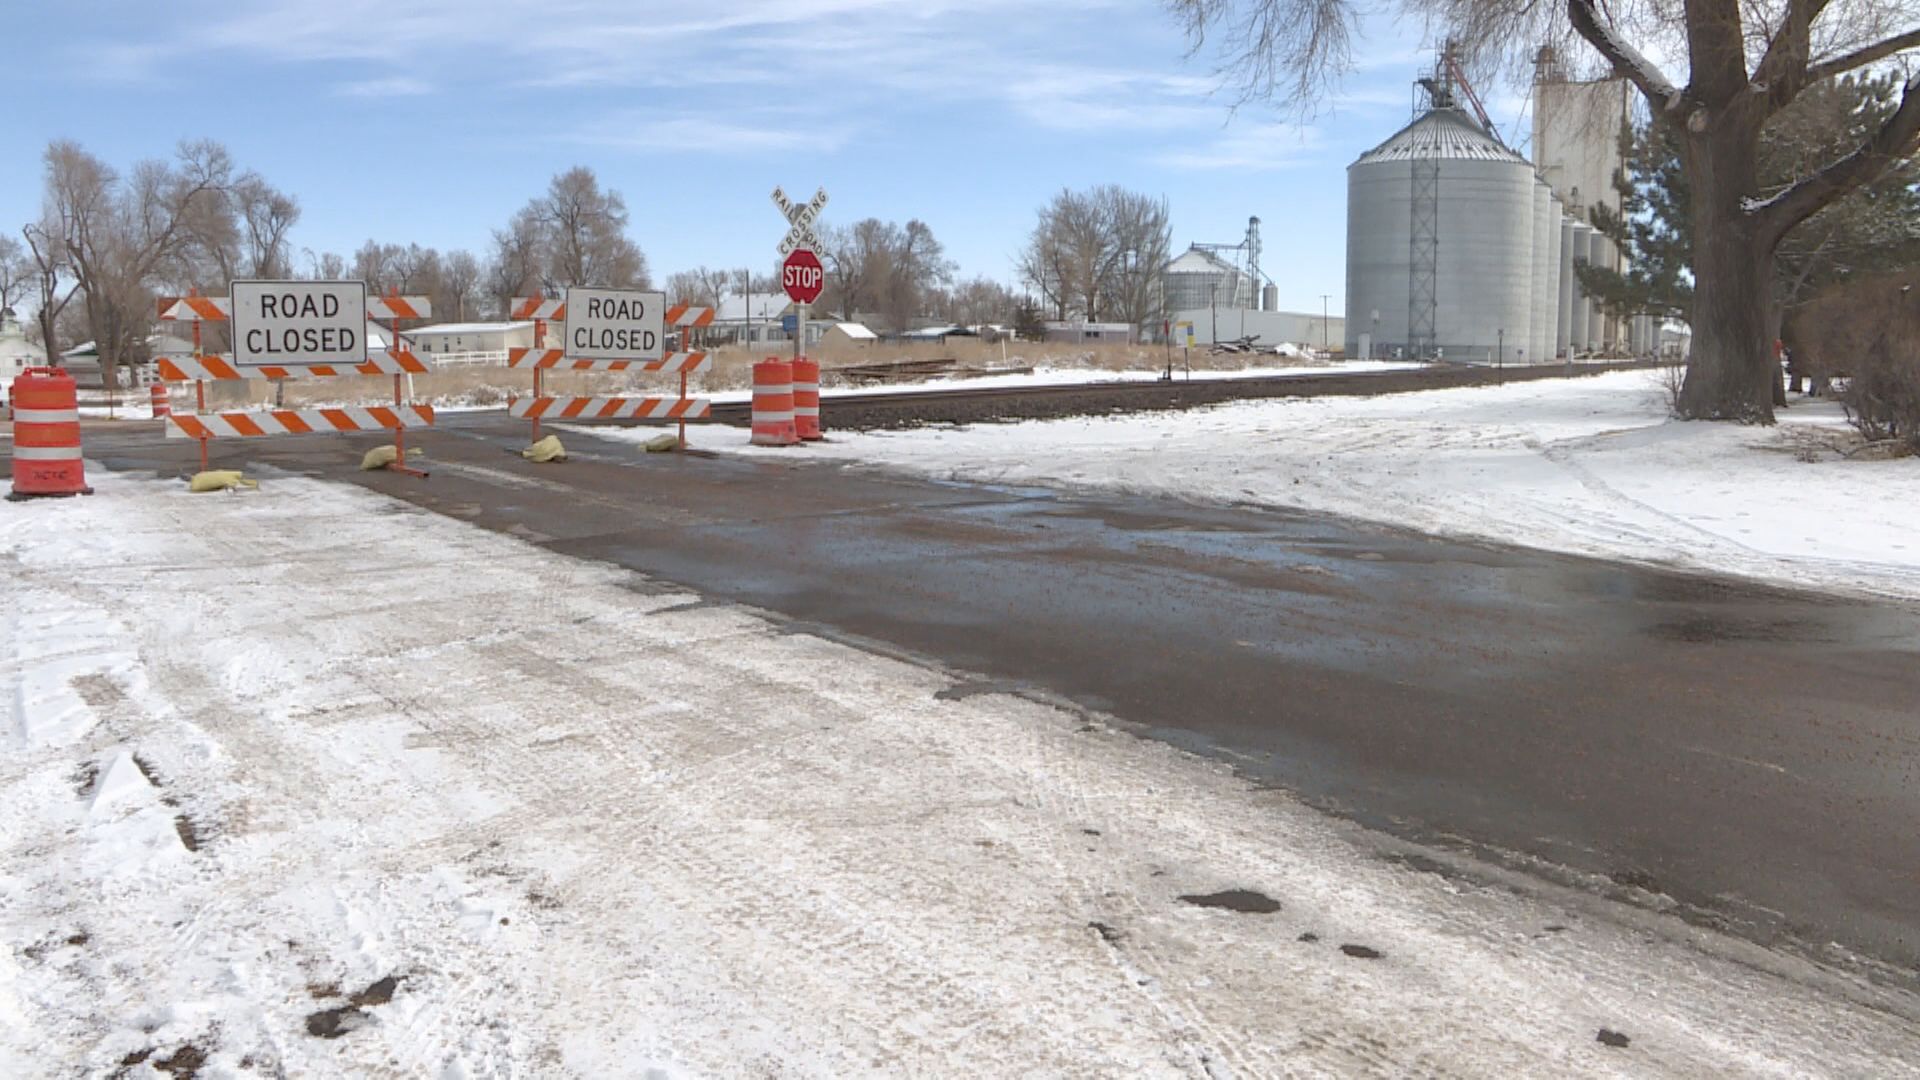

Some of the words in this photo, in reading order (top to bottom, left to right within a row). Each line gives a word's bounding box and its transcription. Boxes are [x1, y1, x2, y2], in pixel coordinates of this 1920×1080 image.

[773, 189, 795, 220] RAIL
[805, 229, 823, 256] OAD
[780, 191, 826, 255] CROSSING
[785, 265, 821, 288] STOP
[261, 293, 339, 318] ROAD
[588, 298, 644, 320] ROAD
[247, 328, 355, 353] CLOSED
[574, 328, 656, 350] CLOSED
